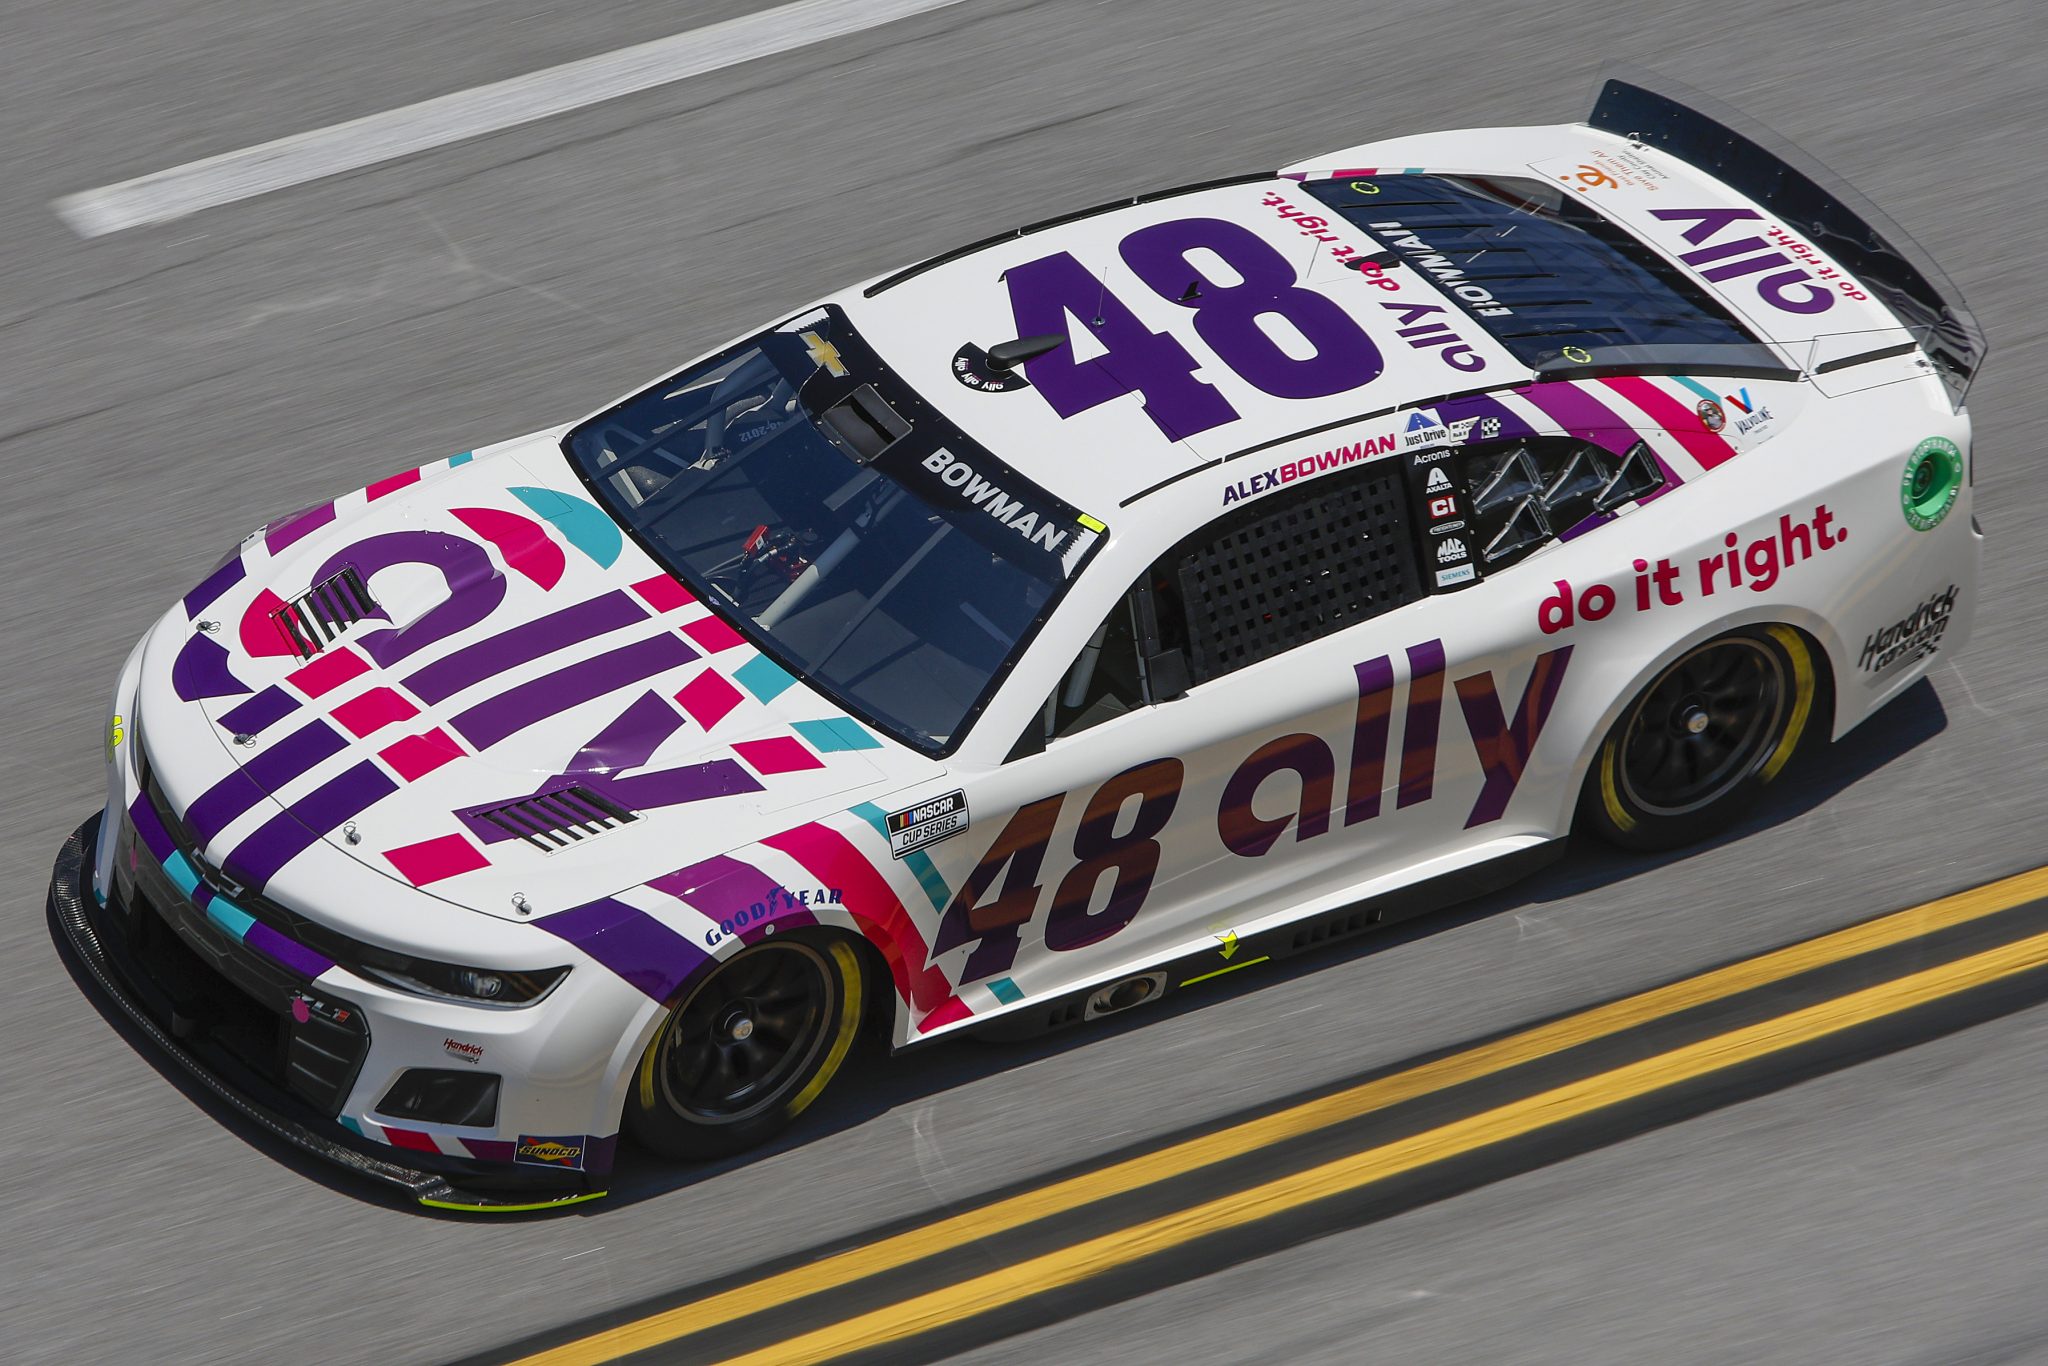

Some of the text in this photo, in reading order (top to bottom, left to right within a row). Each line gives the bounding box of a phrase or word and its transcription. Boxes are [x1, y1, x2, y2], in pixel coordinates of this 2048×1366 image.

[1646, 208, 1836, 314] ally
[1766, 225, 1868, 302] do it right.
[1261, 191, 1487, 374] ally do it right.
[1001, 217, 1385, 443] 48
[981, 381, 1004, 391] ally
[1405, 433, 1423, 447] Just
[1423, 428, 1447, 442] Drive
[1414, 449, 1451, 466] Acronis
[921, 446, 1068, 553] BOWMAN
[1426, 482, 1453, 494] AXALTA
[1431, 497, 1456, 517] CI
[1437, 538, 1466, 558] MAC
[1438, 551, 1467, 563] TOOLS
[1441, 569, 1470, 581] SIEMENS
[1538, 579, 1616, 635] do
[1632, 558, 1684, 611] it
[1698, 504, 1847, 593] right.
[1217, 638, 1575, 857] ally
[913, 797, 954, 824] NASCAR
[902, 815, 958, 846] CUP SERIES
[932, 757, 1184, 987] 48
[443, 1038, 484, 1056] Hendrick
[519, 1145, 580, 1158] SUNOCO
